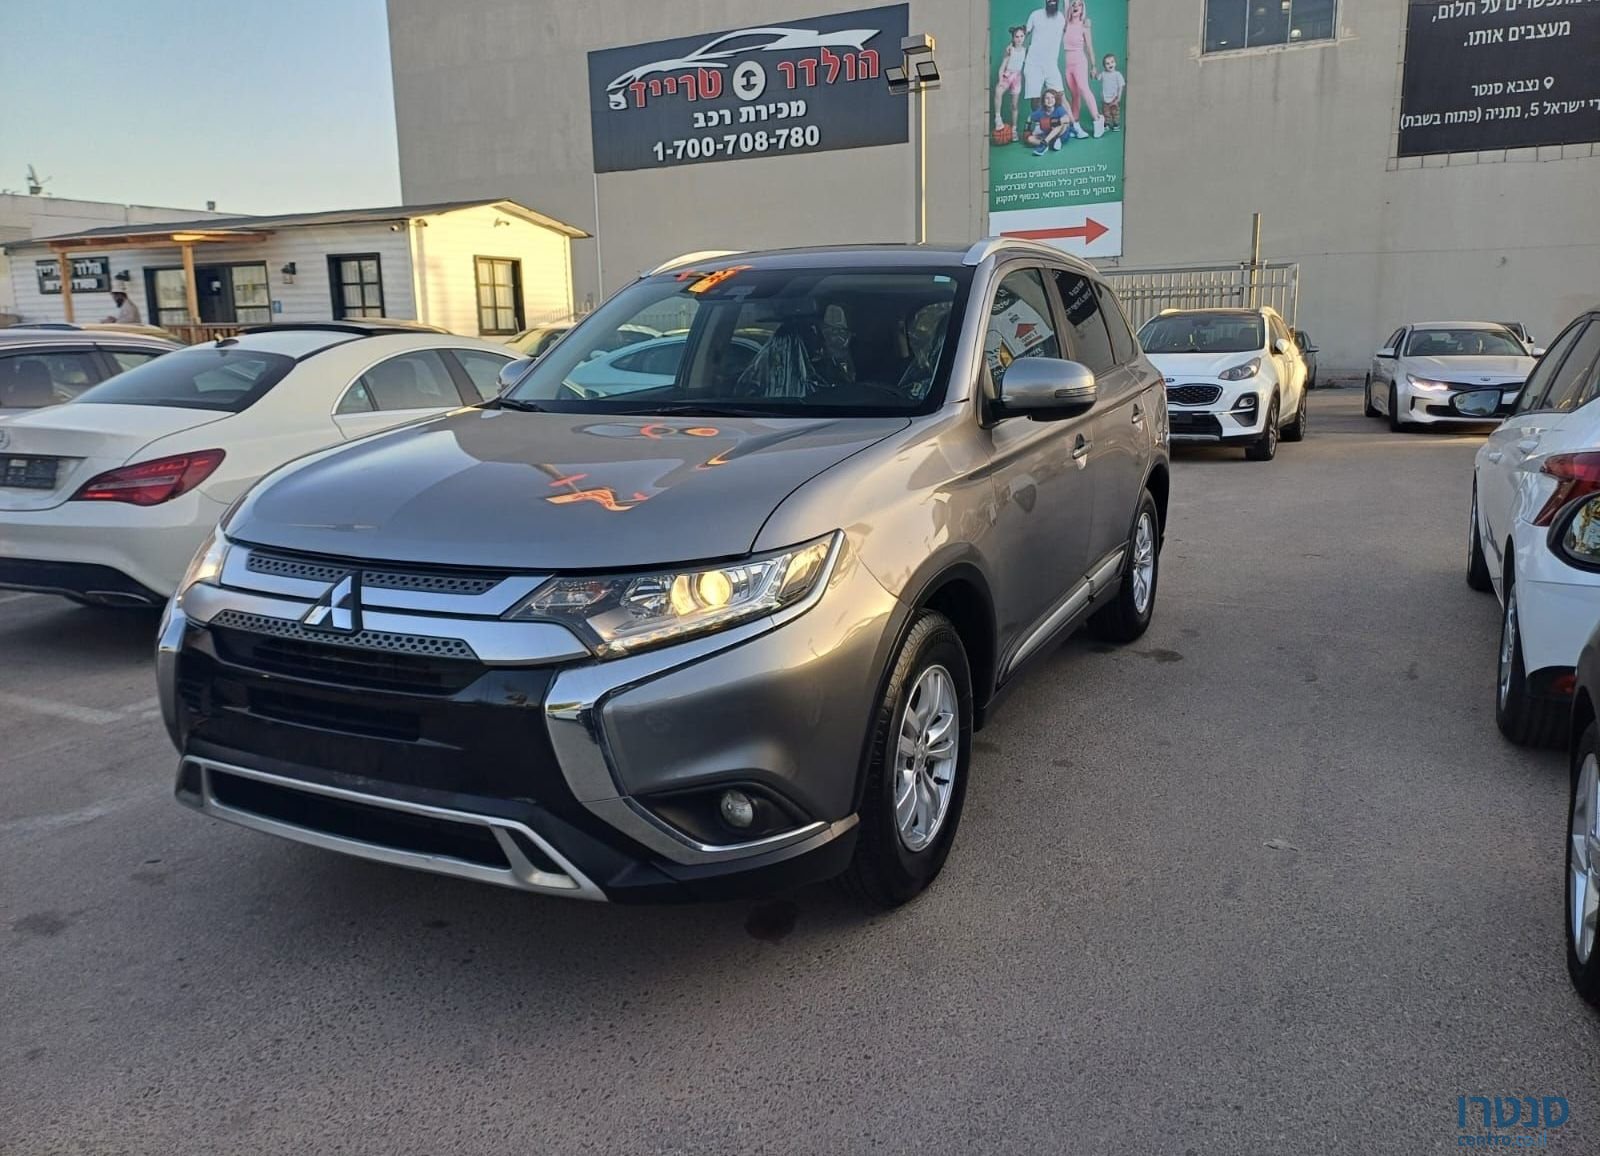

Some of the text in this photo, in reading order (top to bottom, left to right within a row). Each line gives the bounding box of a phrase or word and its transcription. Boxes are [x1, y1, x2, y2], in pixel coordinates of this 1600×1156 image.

[1432, 0, 1582, 23] שרים על חלום,
[1463, 20, 1571, 47] מעצבים אותו.
[629, 47, 879, 108] הולדר טרייד
[1471, 78, 1540, 97] נצבא סנטר
[693, 99, 807, 129] מכירת רכב
[1445, 106, 1482, 124] (פתוח
[1485, 105, 1522, 121] נתניה
[1543, 100, 1585, 115] ישראל
[1400, 113, 1441, 130] בשבת)
[653, 125, 820, 162] 1-700-708-780
[1096, 163, 1108, 172] על
[1105, 173, 1117, 182] על
